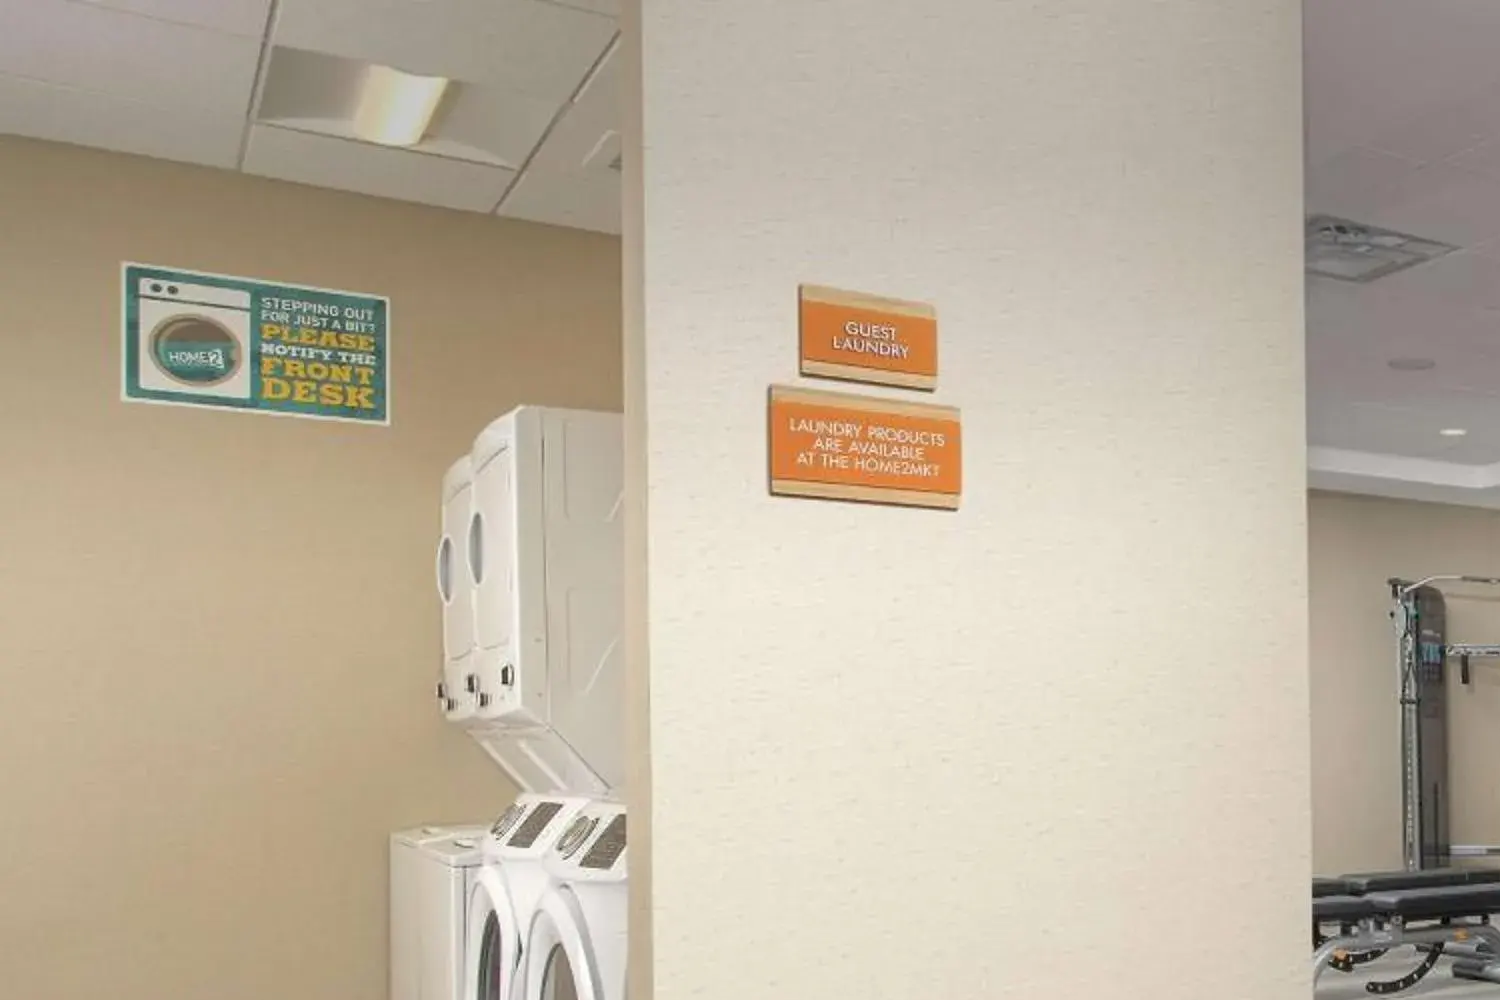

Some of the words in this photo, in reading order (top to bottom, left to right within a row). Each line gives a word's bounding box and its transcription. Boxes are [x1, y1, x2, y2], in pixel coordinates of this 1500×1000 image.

[261, 298, 339, 317] STEPPING
[344, 307, 375, 321] OUT
[261, 309, 290, 324] FOR
[293, 314, 329, 330] JUST
[331, 321, 341, 330] A
[345, 320, 376, 334] BIT?
[260, 323, 375, 351] PLEASE
[845, 321, 897, 341] GUEST
[260, 343, 333, 361] NOTIFY
[337, 351, 376, 366] THE
[833, 336, 909, 359] LAUNDRY
[261, 356, 375, 385] FRONT
[261, 377, 375, 409] DESK
[789, 417, 863, 438] LAUNDRY
[867, 425, 945, 447] PRODUCTS
[814, 438, 843, 452] ARE
[849, 441, 925, 461] AVAILABLE
[797, 452, 816, 465] AT
[821, 454, 849, 469] THE
[854, 457, 940, 477] HOME2MKT
